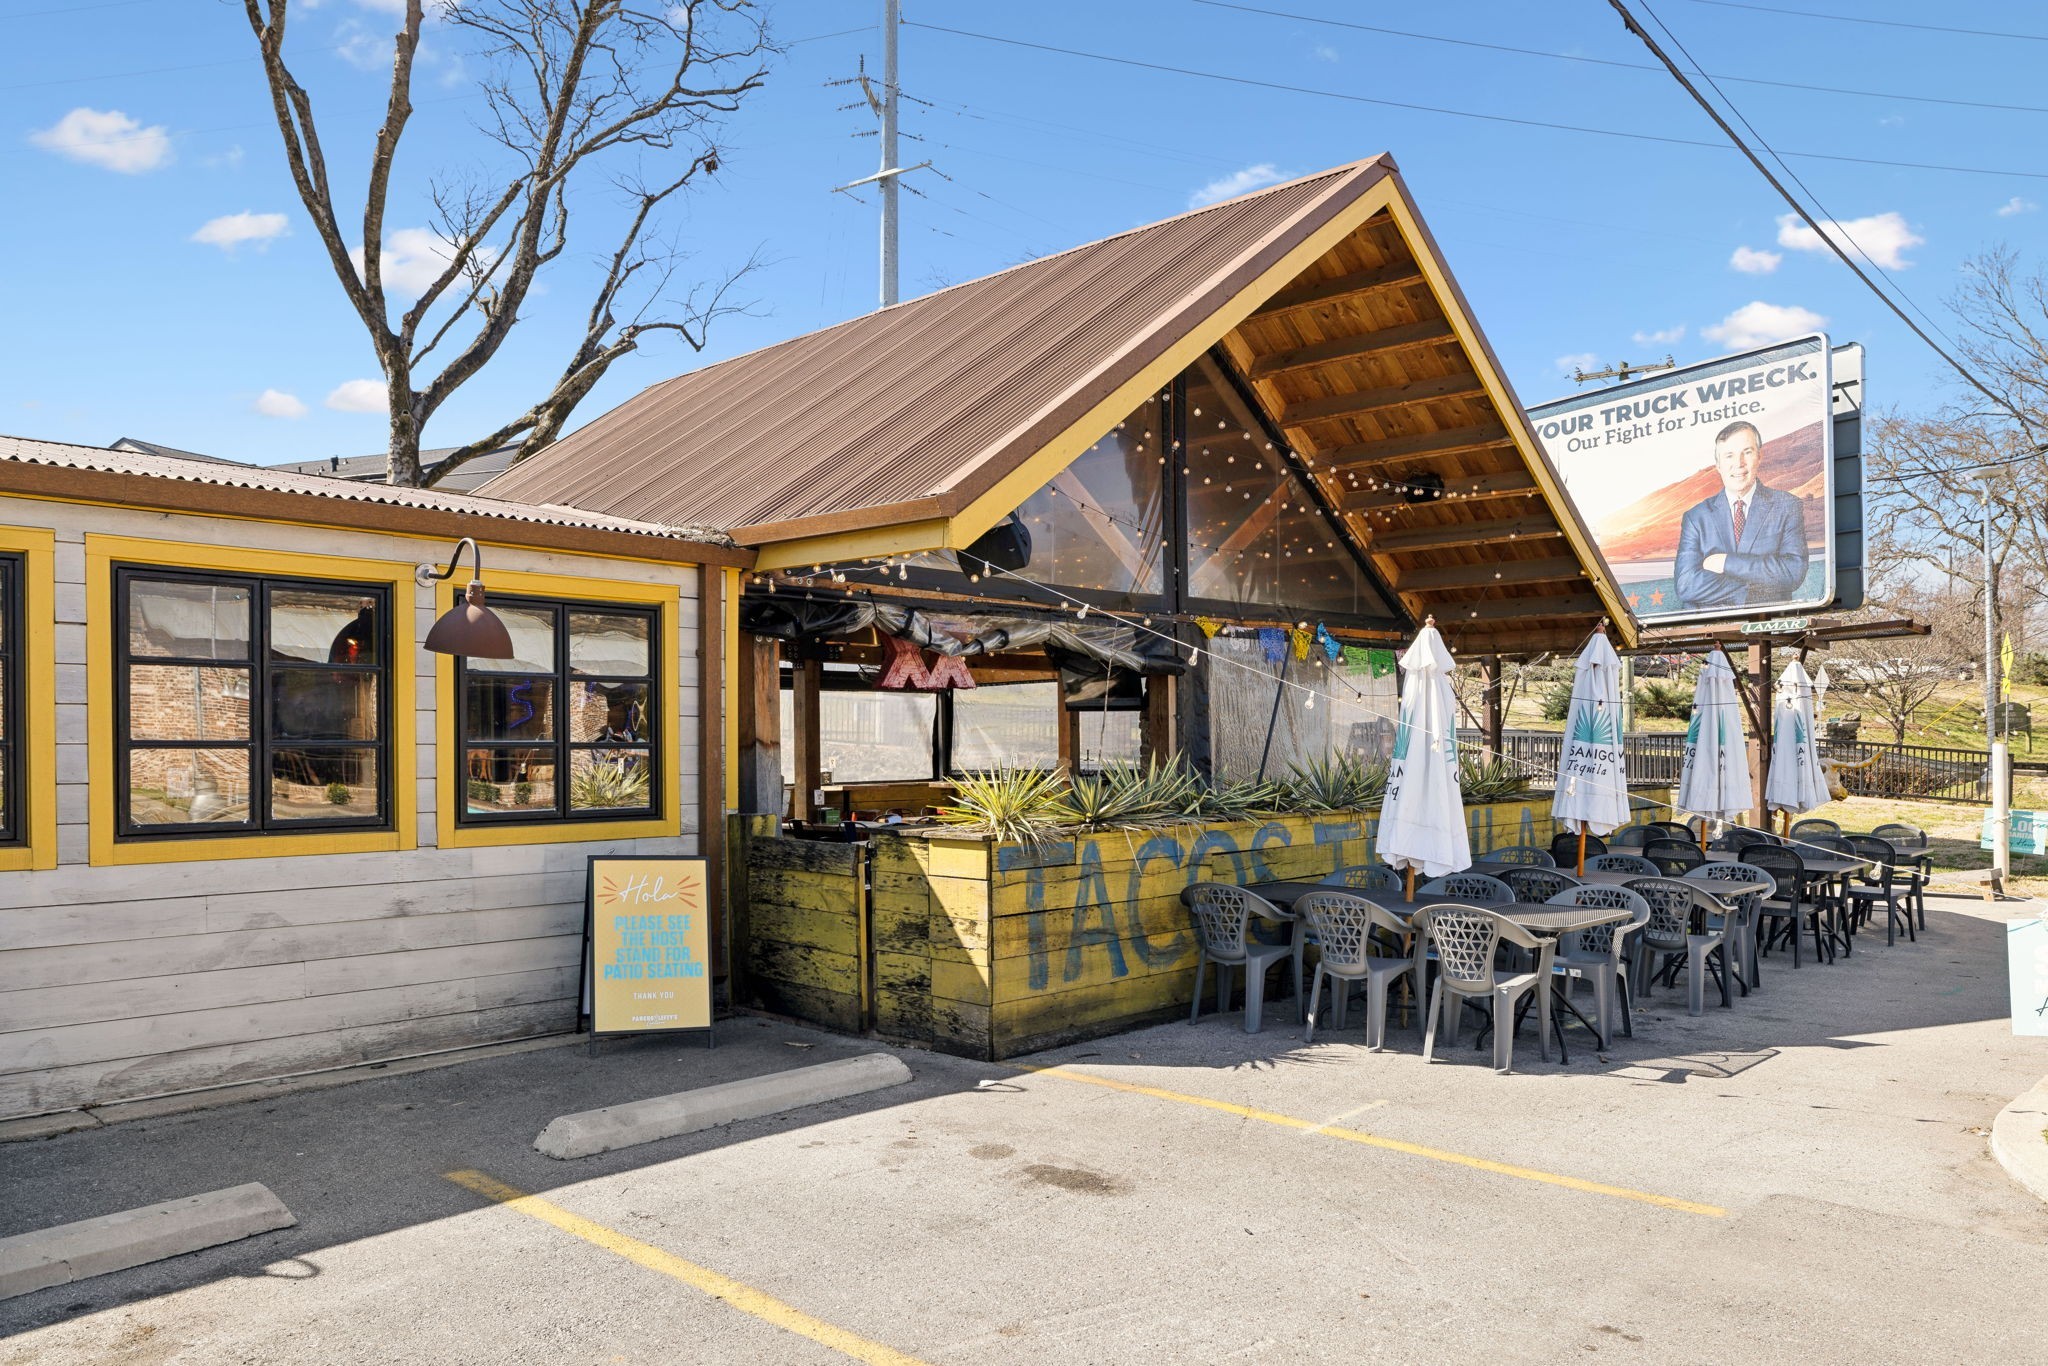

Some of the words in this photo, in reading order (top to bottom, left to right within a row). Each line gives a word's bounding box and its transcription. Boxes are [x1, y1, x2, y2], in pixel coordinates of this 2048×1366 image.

[1600, 389, 1688, 426] TRUCK
[1696, 361, 1817, 404] WRECK.
[1567, 436, 1601, 453] Our
[1605, 423, 1652, 446] Fight
[1657, 417, 1685, 434] for
[1690, 400, 1765, 427] Justice.
[1746, 619, 1801, 633] LAMAR
[1567, 759, 1608, 776] Tequila
[619, 874, 678, 904] Hola
[614, 914, 663, 931] PLEASE
[667, 914, 692, 930] SEE
[621, 931, 645, 946] THE
[651, 931, 684, 946] HOST
[615, 947, 661, 963] STAND
[665, 946, 690, 961] FOR
[604, 963, 642, 980] PATIO
[647, 961, 703, 979] SEATING
[633, 991, 657, 1000] THANK
[660, 991, 674, 999] YOU
